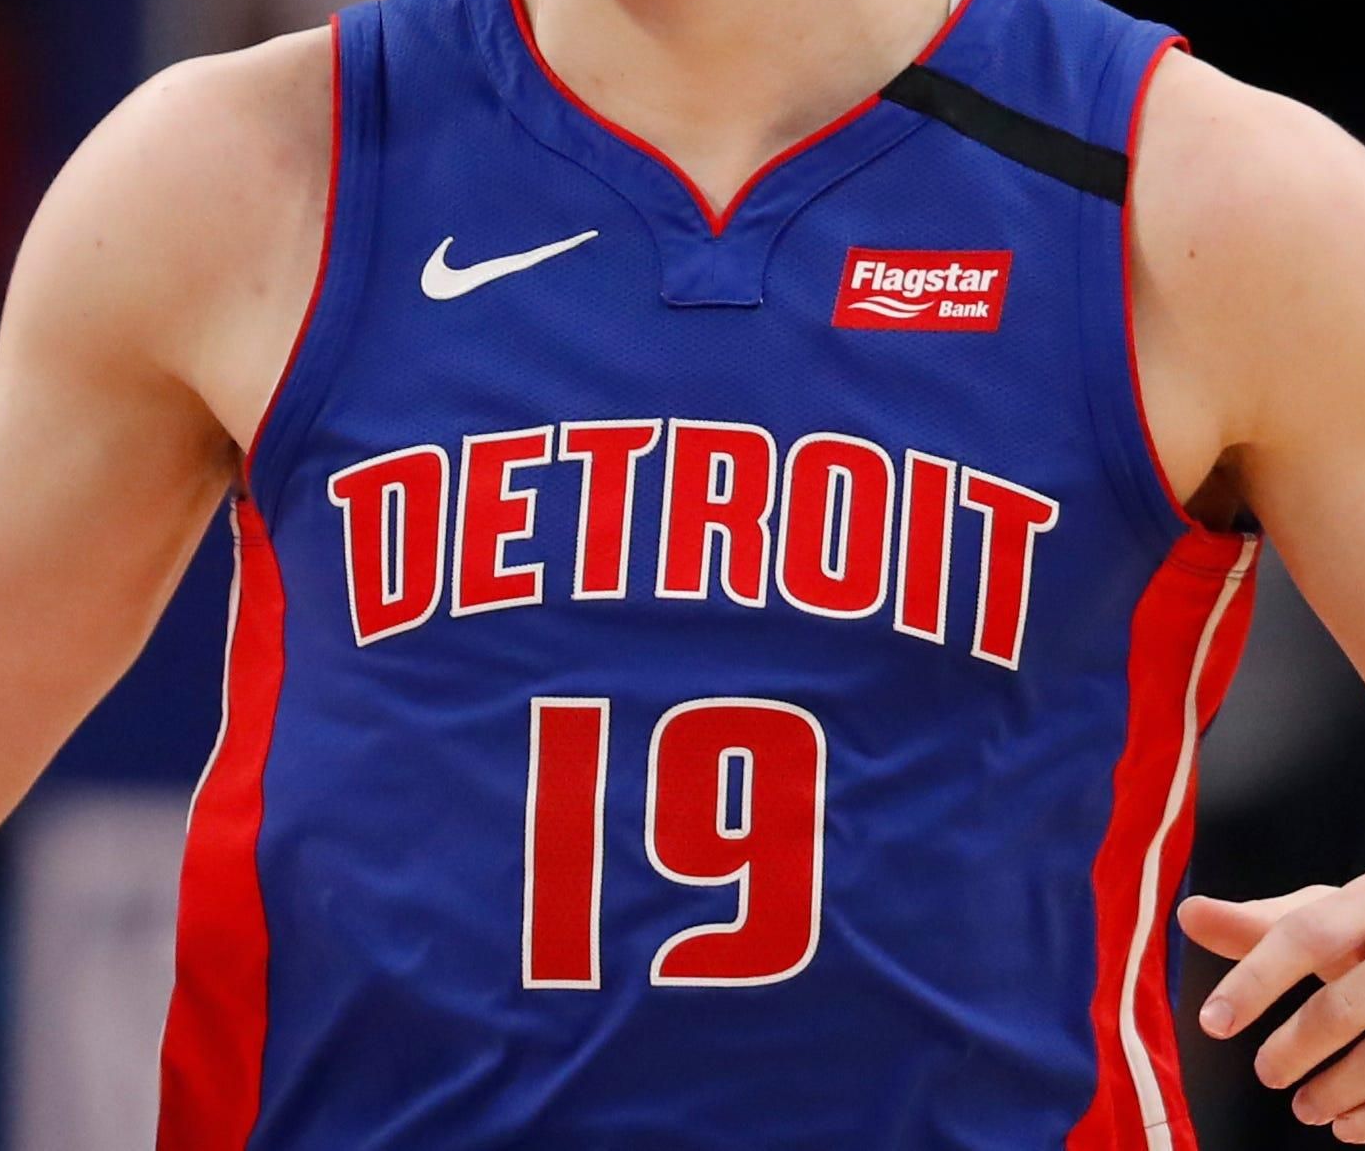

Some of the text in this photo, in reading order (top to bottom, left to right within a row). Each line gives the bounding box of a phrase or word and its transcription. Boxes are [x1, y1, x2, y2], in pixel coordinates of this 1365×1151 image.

[850, 260, 999, 298] Flagstar
[938, 300, 990, 318] Bank
[327, 418, 1060, 671] DETROIT
[522, 697, 827, 990] 19
